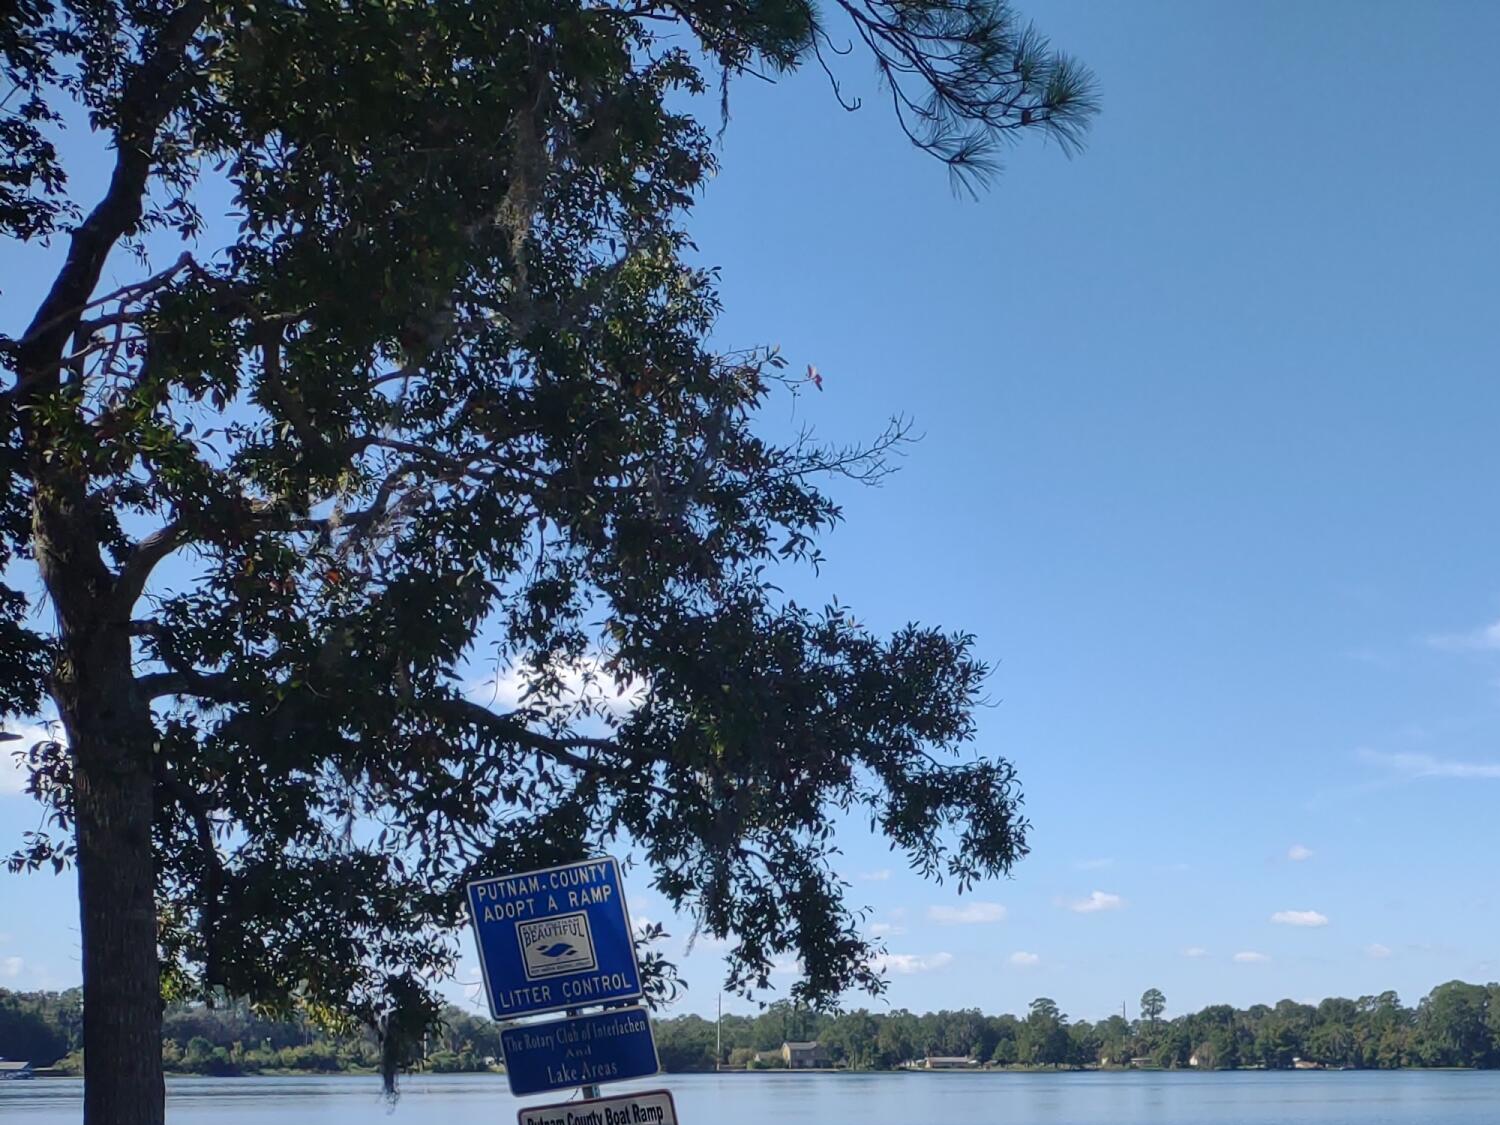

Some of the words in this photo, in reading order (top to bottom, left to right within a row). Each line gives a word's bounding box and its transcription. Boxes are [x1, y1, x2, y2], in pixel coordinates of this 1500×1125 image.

[478, 876, 540, 902] PUTNAM
[549, 863, 607, 889] COUNTY
[484, 898, 535, 922] ADOPT
[548, 895, 558, 911] A
[568, 885, 612, 908] RAMP
[523, 921, 584, 947] BEAUTIFUL
[500, 986, 551, 1008] LITTER
[562, 973, 632, 998] CONTROL
[505, 1037, 522, 1052] The
[524, 1033, 555, 1051] Rotary
[556, 1026, 578, 1044] Club
[582, 1024, 591, 1040] of
[592, 1017, 646, 1038] Interlachen
[566, 1047, 592, 1058] And
[547, 1066, 576, 1084] Lake
[582, 1061, 618, 1079] Areas
[633, 1103, 663, 1125] Ramp
